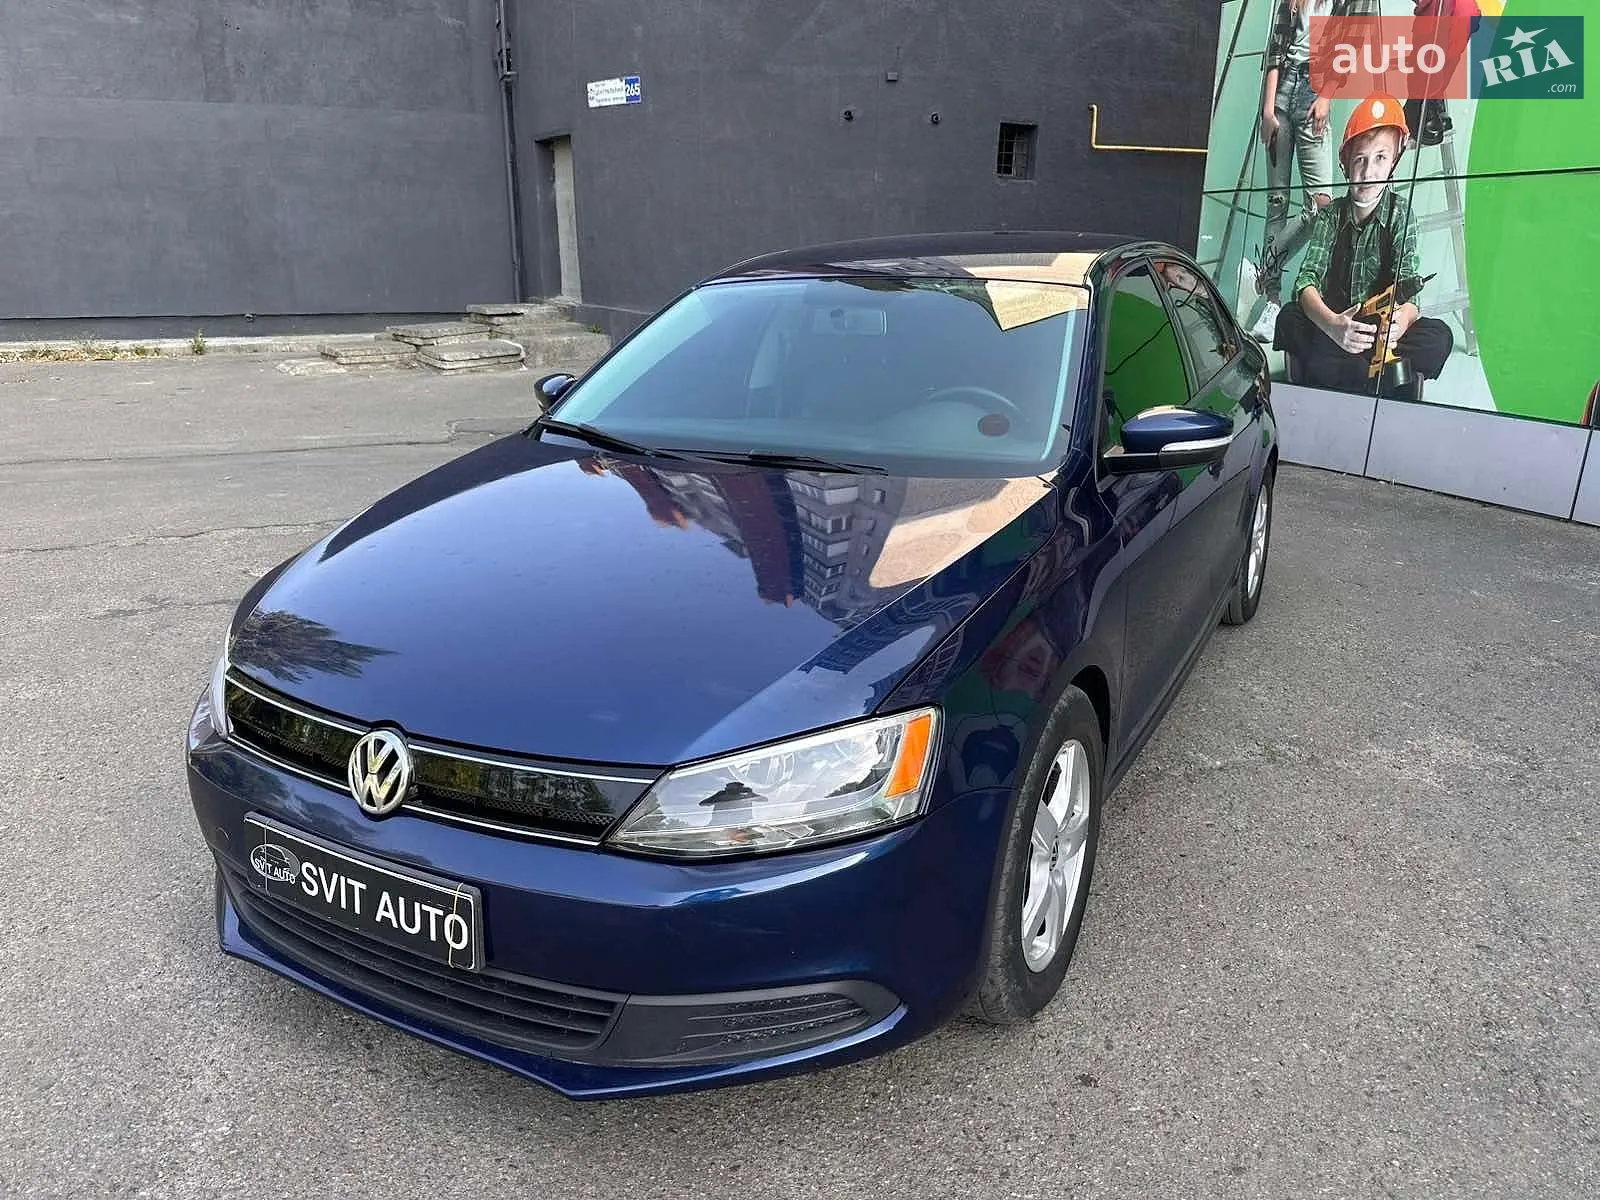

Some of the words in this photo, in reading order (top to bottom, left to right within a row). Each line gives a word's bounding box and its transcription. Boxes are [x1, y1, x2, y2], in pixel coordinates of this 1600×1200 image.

[625, 83, 641, 97] 265
[254, 857, 273, 874] SVIT
[273, 866, 296, 884] AUTO
[301, 861, 367, 915] SVIT
[375, 890, 469, 950] AUTO
